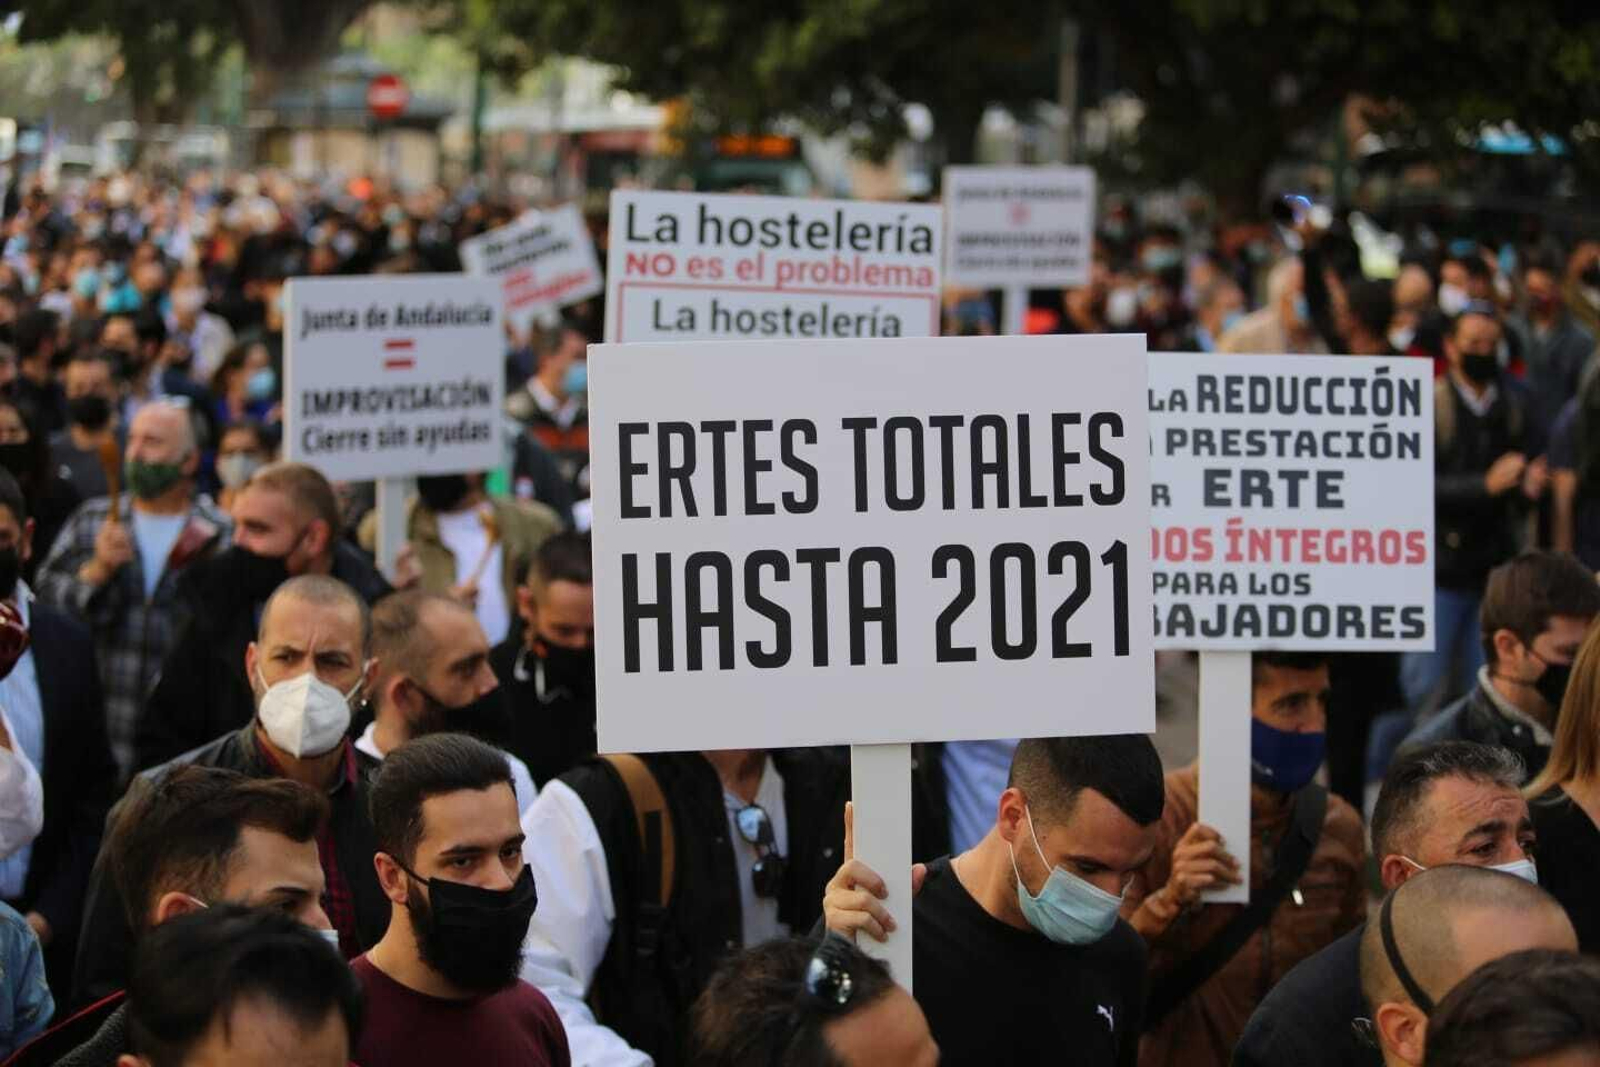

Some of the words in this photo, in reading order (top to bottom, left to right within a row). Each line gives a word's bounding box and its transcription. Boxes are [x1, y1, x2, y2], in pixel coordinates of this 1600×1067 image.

[625, 203, 678, 243] La
[699, 204, 932, 253] hostelería
[625, 253, 676, 276] NO
[687, 256, 723, 279] es
[735, 253, 764, 282] el
[776, 256, 933, 291] problema
[302, 306, 357, 340] Junta
[365, 304, 387, 328] de
[396, 301, 492, 327] Andalucía
[653, 300, 695, 331] La
[711, 300, 900, 337] hostelería
[303, 379, 491, 418] IMPROVISACIÓN
[1149, 389, 1188, 411] LA
[1197, 366, 1421, 417] REDUCCIÓN
[303, 424, 370, 453] Cierre
[378, 420, 407, 447] sin
[415, 419, 490, 452] ayudas
[1166, 423, 1420, 459] PRESTACIÓN
[618, 418, 818, 518] ERTES
[842, 412, 1126, 512] TOTALES
[1204, 469, 1344, 508] ERTE
[1225, 517, 1427, 564] ÍNTEGROS
[1153, 572, 1238, 595] PARA
[1249, 573, 1311, 595] LOS
[622, 546, 898, 673] HASTA
[932, 539, 1130, 663] 2021
